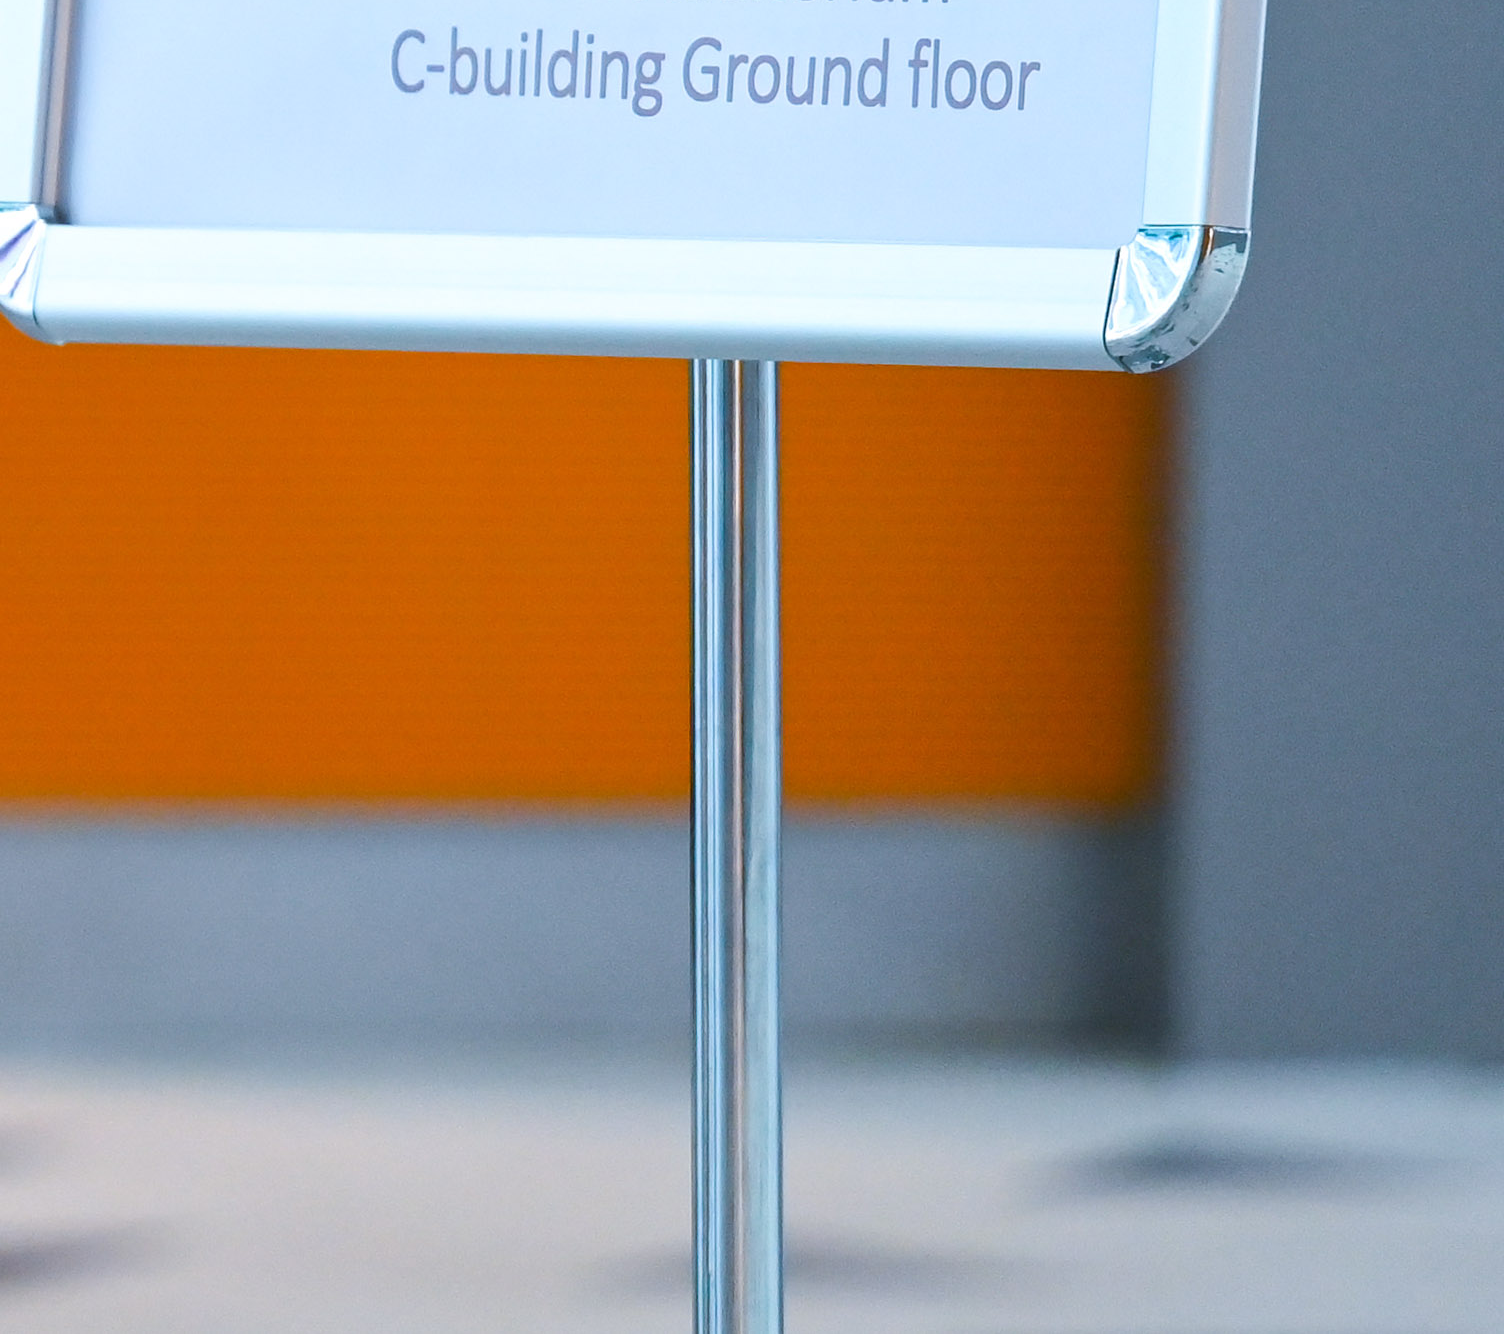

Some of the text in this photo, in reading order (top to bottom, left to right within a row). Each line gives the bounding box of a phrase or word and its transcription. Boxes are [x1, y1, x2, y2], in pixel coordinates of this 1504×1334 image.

[391, 26, 1041, 118] C-building Ground floor
